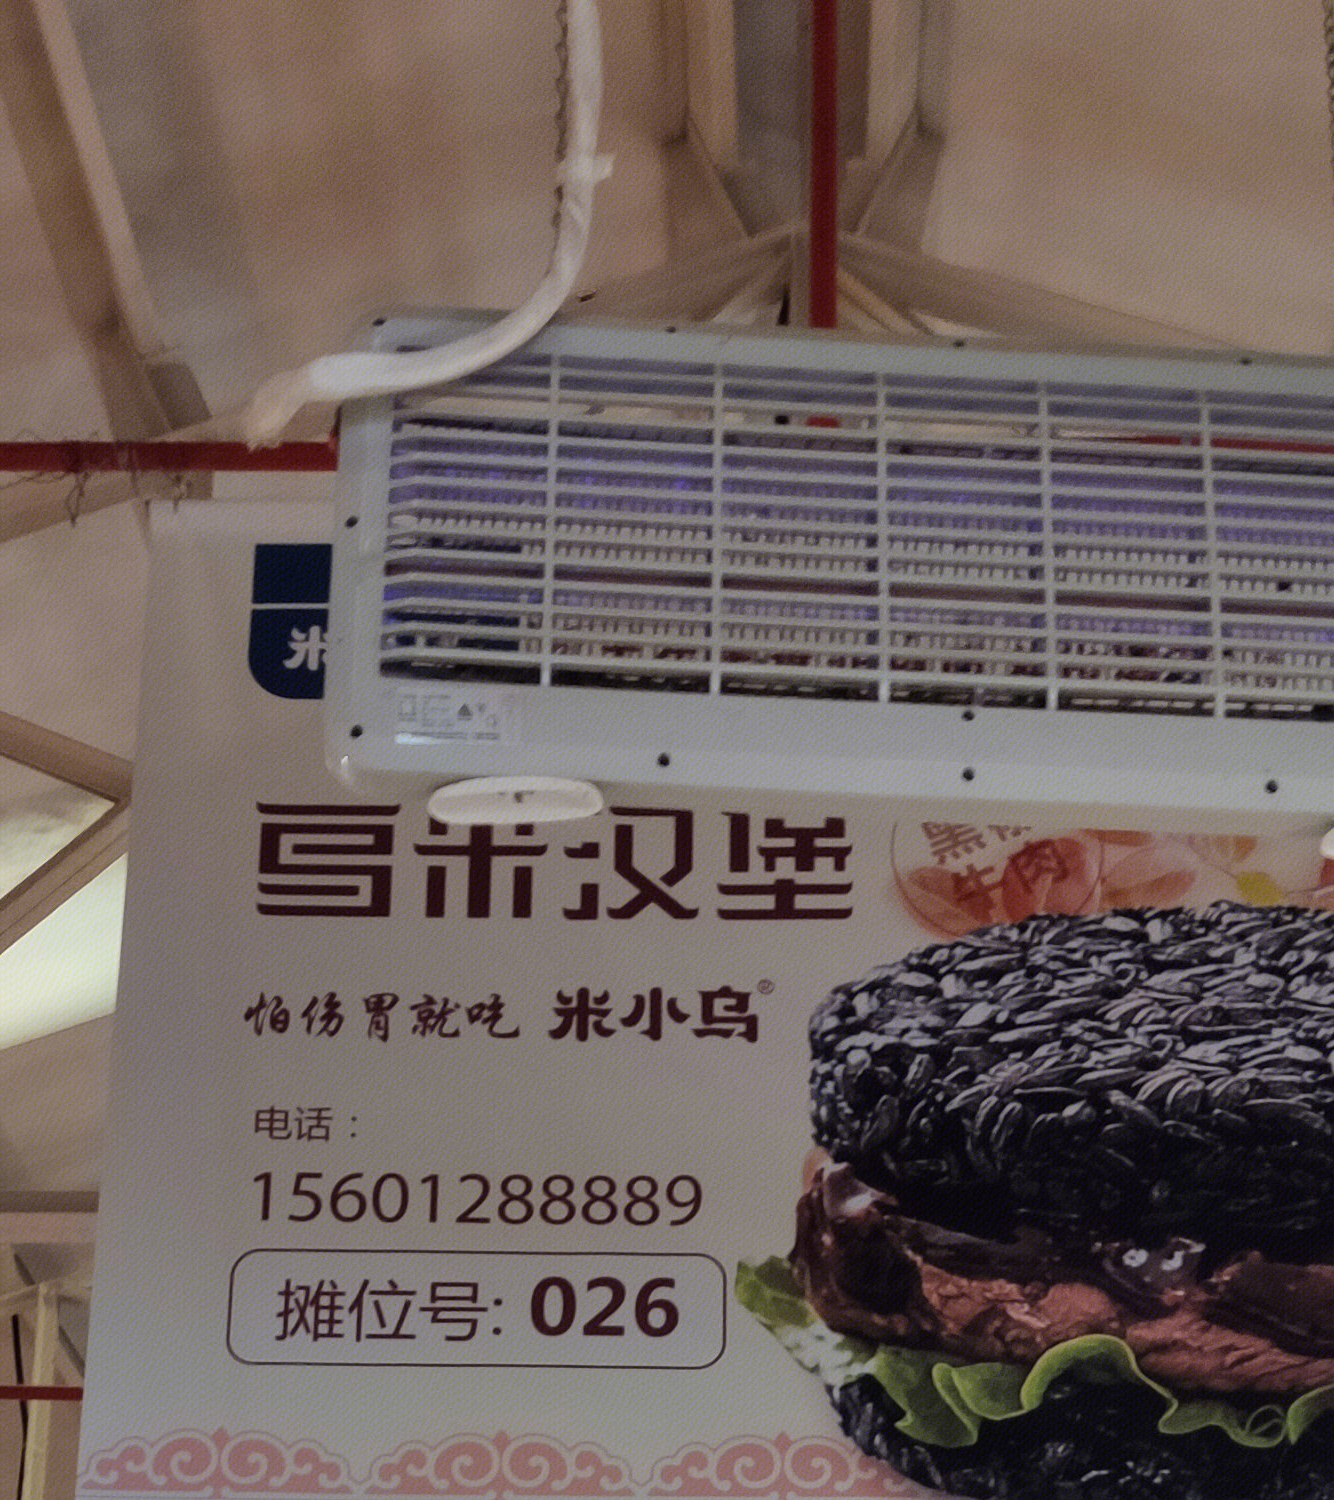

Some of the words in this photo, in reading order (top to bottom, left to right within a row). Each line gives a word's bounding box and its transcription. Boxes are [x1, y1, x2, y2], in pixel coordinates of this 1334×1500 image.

[244, 991, 520, 1043] 怕伤胃就吃
[252, 1171, 703, 1226] 15601288889
[274, 1278, 503, 1343] 摊位号:
[529, 1276, 680, 1338] 026
